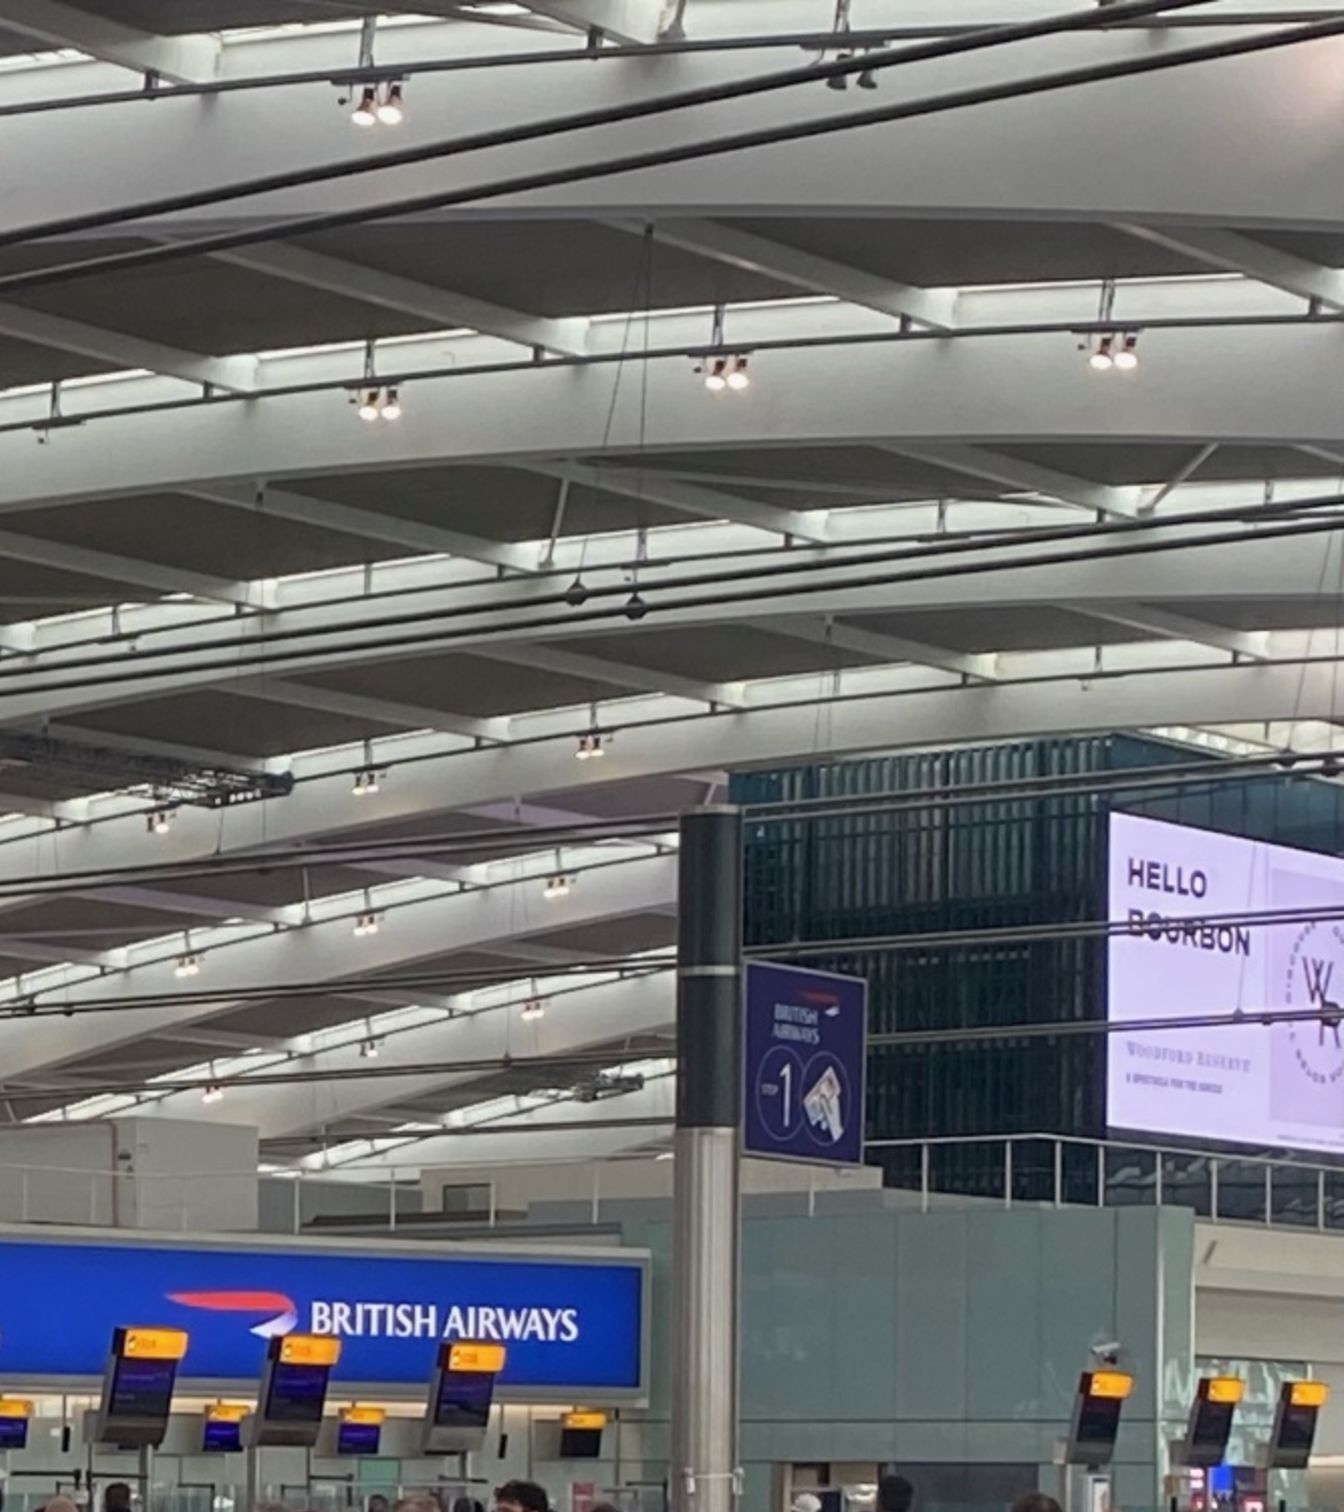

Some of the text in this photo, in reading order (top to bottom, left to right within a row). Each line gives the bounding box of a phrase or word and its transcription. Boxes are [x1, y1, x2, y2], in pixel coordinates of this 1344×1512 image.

[1127, 857, 1207, 899] HELLO
[779, 1063, 792, 1128] 1
[311, 1301, 579, 1343] BRITISH AIRWAYS
